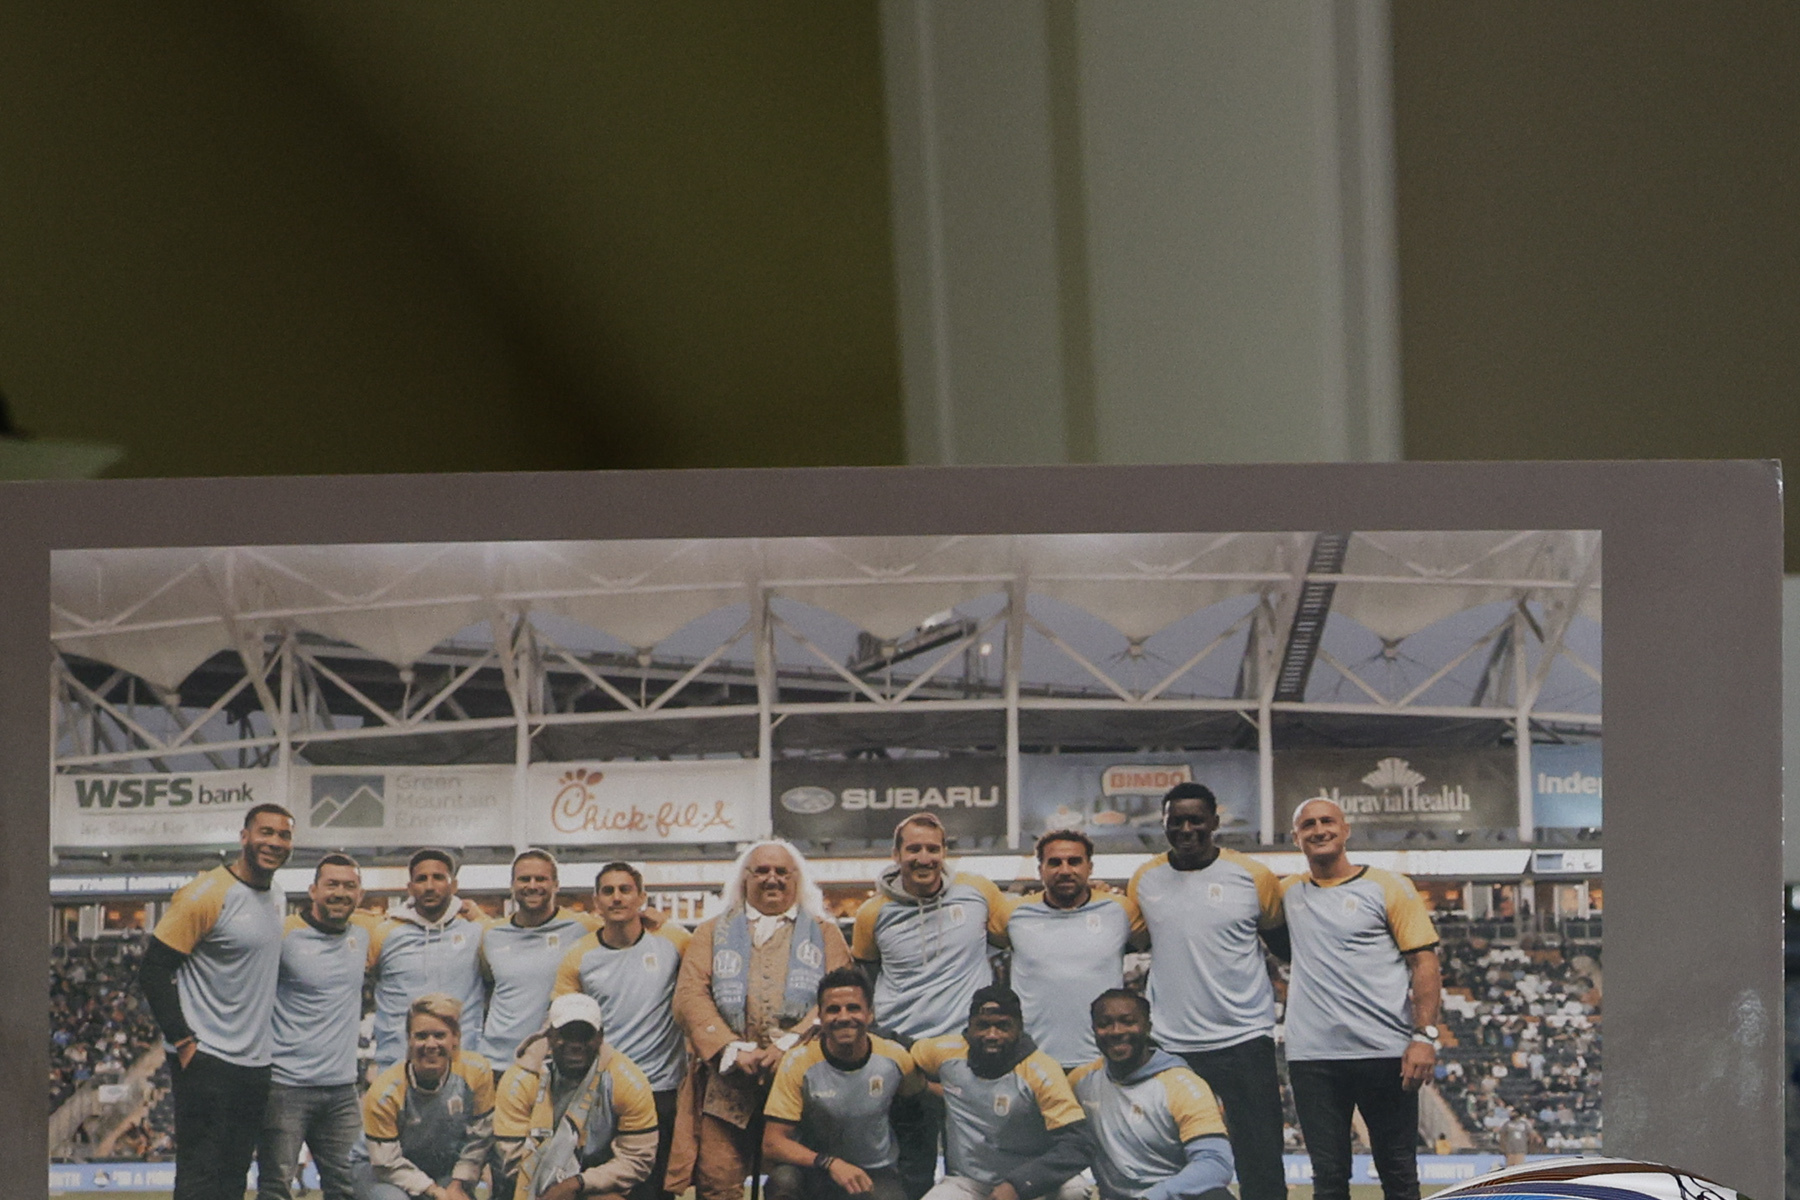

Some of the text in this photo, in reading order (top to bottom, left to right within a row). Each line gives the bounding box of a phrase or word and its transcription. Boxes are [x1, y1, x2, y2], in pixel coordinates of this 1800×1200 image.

[395, 774, 463, 792] Green
[1109, 771, 1186, 789] BIMBO
[75, 777, 255, 809] WSFS bank
[840, 786, 999, 810] SUBARU
[551, 778, 735, 837] Chick-fil-A
